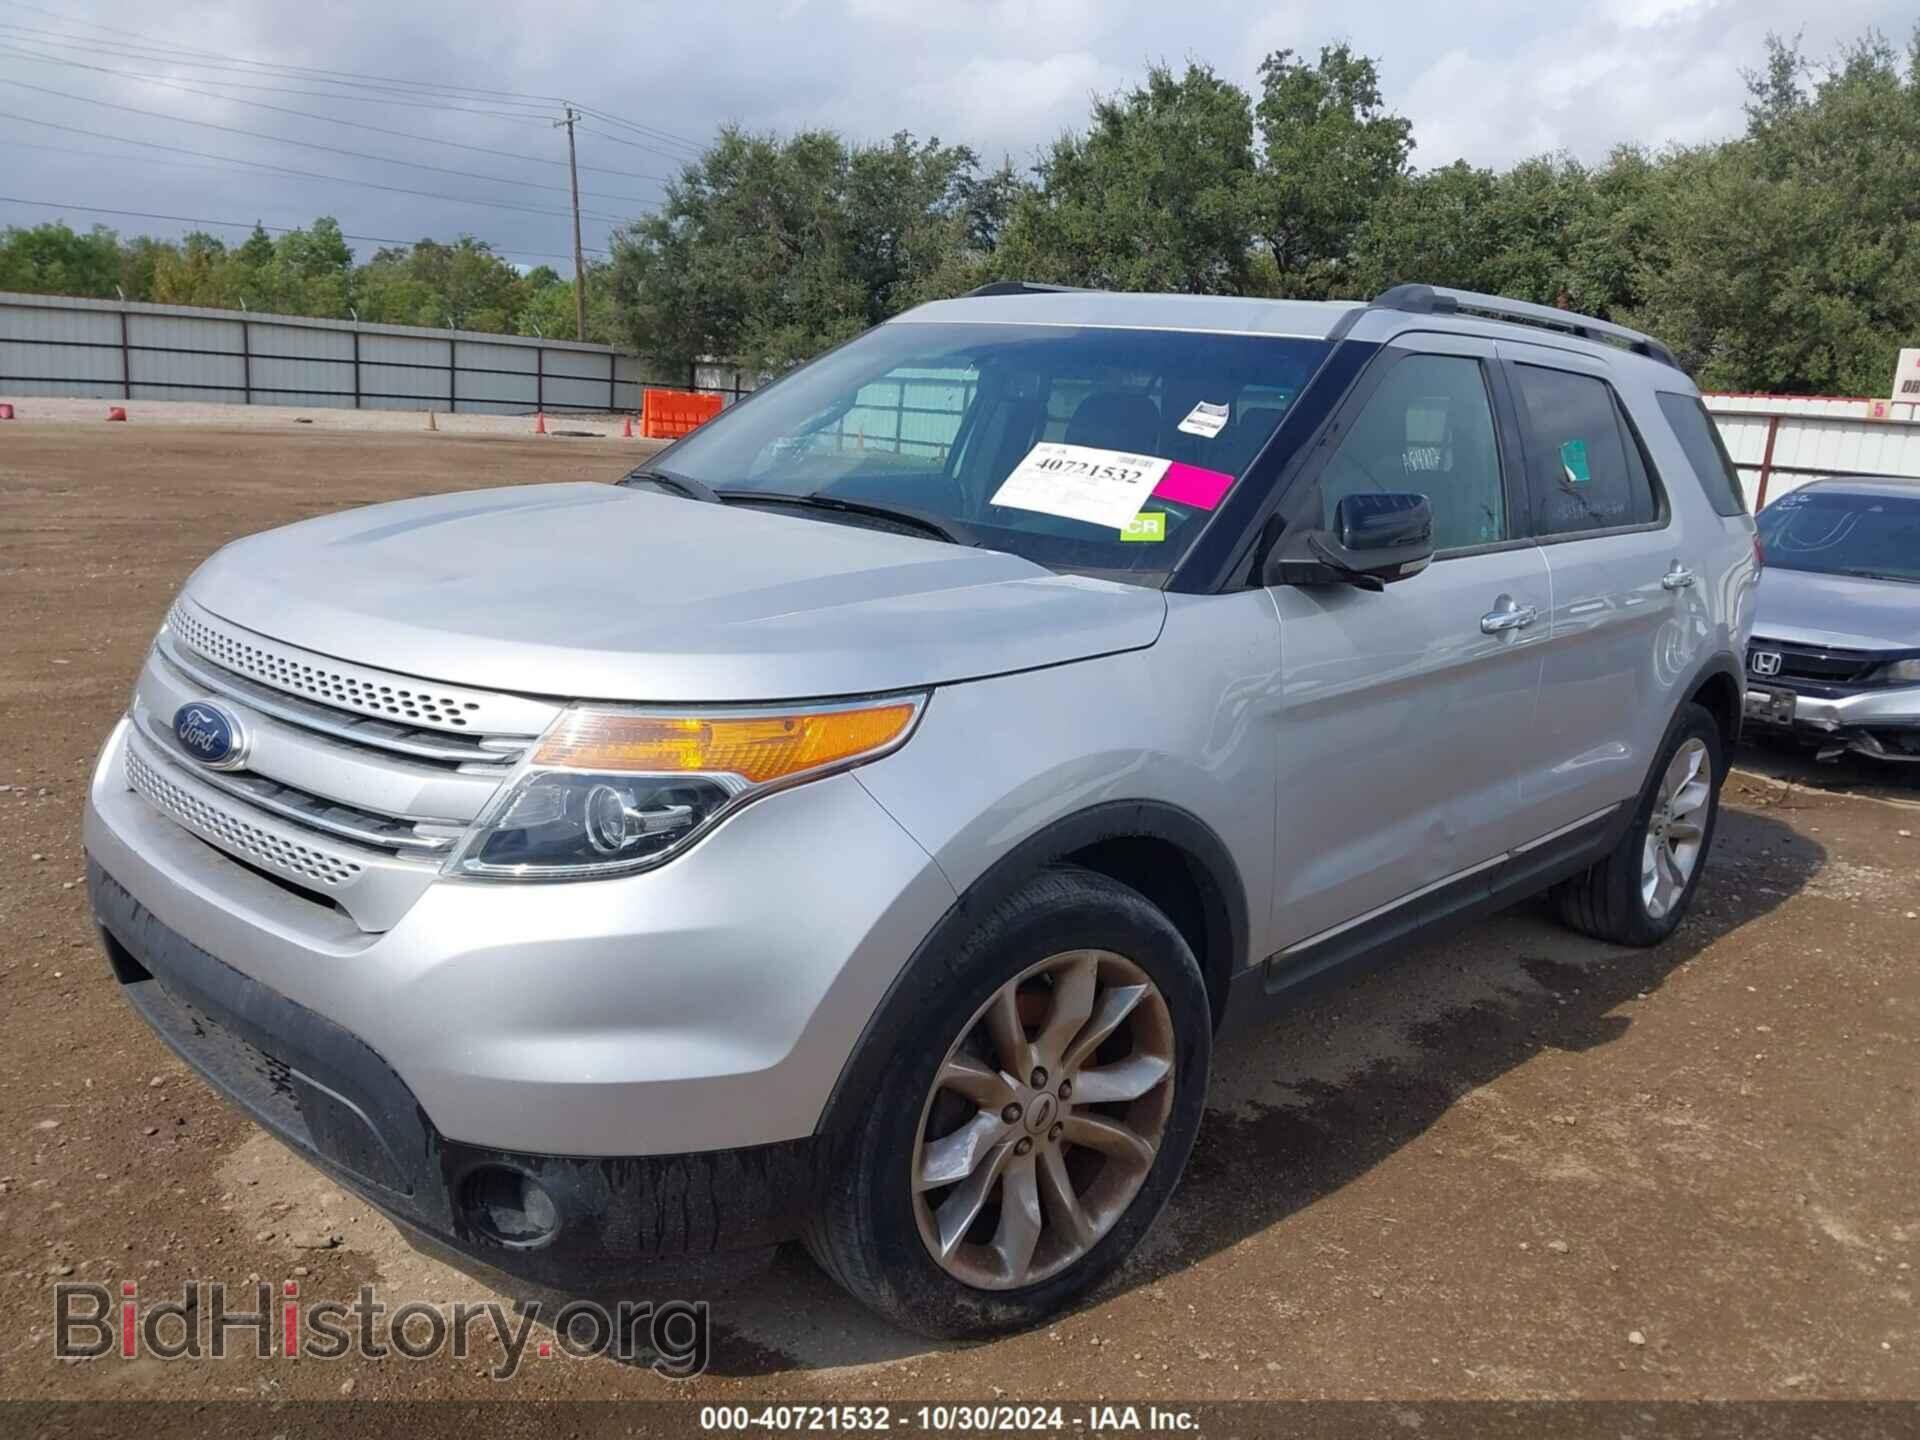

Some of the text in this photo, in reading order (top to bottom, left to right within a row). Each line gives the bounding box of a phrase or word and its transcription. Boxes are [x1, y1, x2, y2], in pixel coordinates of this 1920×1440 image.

[1035, 458, 1142, 484] 40721532
[1127, 519, 1158, 534] CR
[180, 709, 219, 752] Ford
